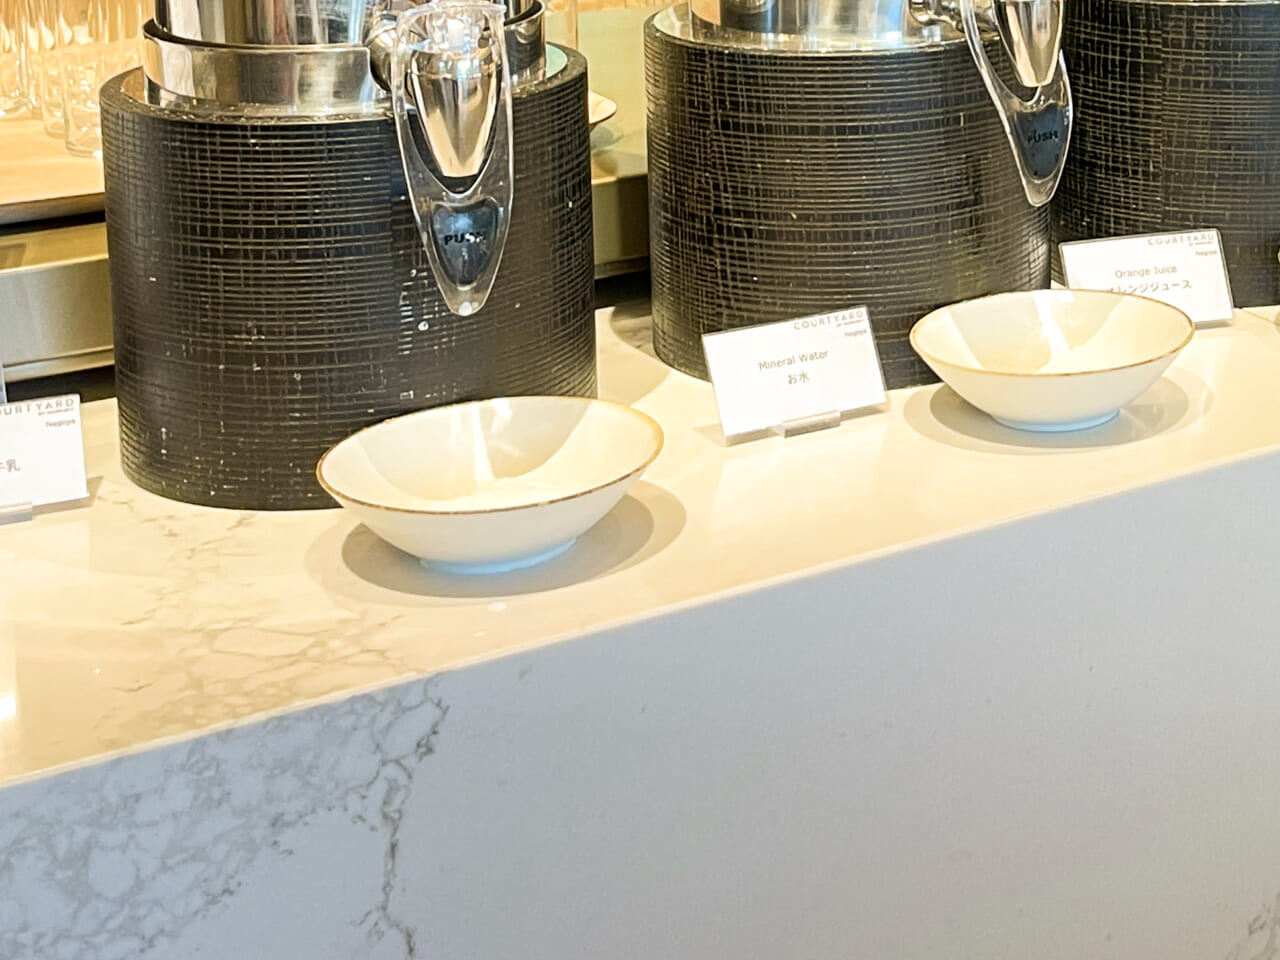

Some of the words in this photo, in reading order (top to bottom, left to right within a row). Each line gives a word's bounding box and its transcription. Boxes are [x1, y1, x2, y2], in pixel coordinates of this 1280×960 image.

[1027, 129, 1059, 145] PUSH
[1147, 233, 1215, 246] COURTYARD
[1114, 268, 1151, 279] Orange
[1153, 264, 1178, 275] Juice
[793, 309, 864, 331] COURTYARD
[758, 355, 796, 371] Mineral
[798, 349, 830, 364] Water
[786, 370, 811, 386] お水
[0, 398, 74, 416] URTYARD
